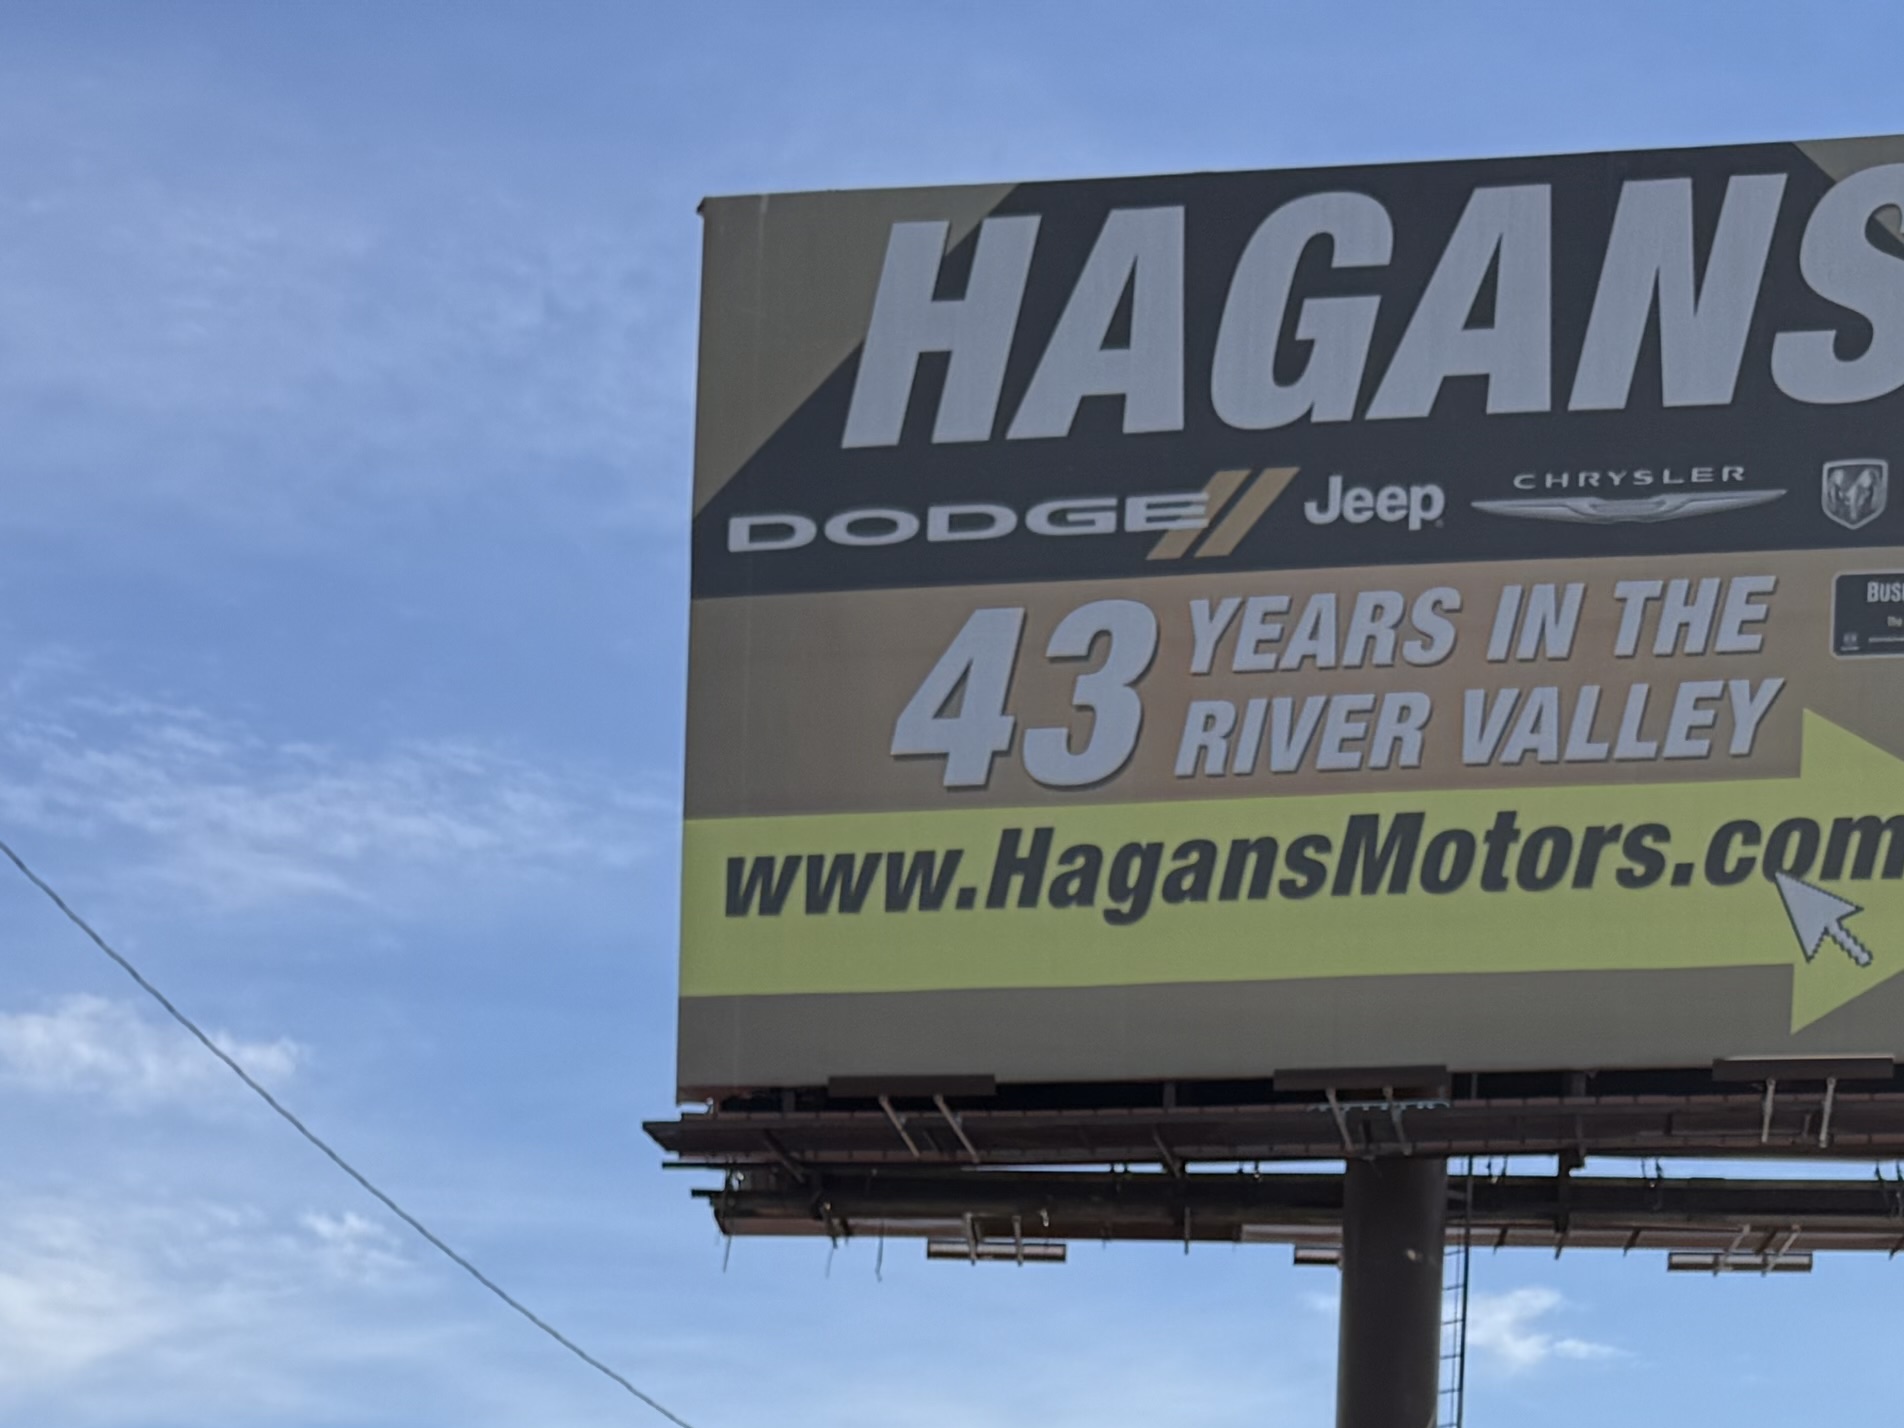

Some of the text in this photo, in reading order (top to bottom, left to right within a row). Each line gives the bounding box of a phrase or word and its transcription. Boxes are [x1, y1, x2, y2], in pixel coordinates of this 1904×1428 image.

[1304, 474, 1444, 531] Jeep
[1514, 464, 1747, 490] CHRYSLER
[728, 492, 1209, 553] DODGE
[1187, 575, 1778, 675] YEARS IN THE
[891, 599, 1159, 789] 43
[1173, 676, 1786, 777] RIVER VALLEY
